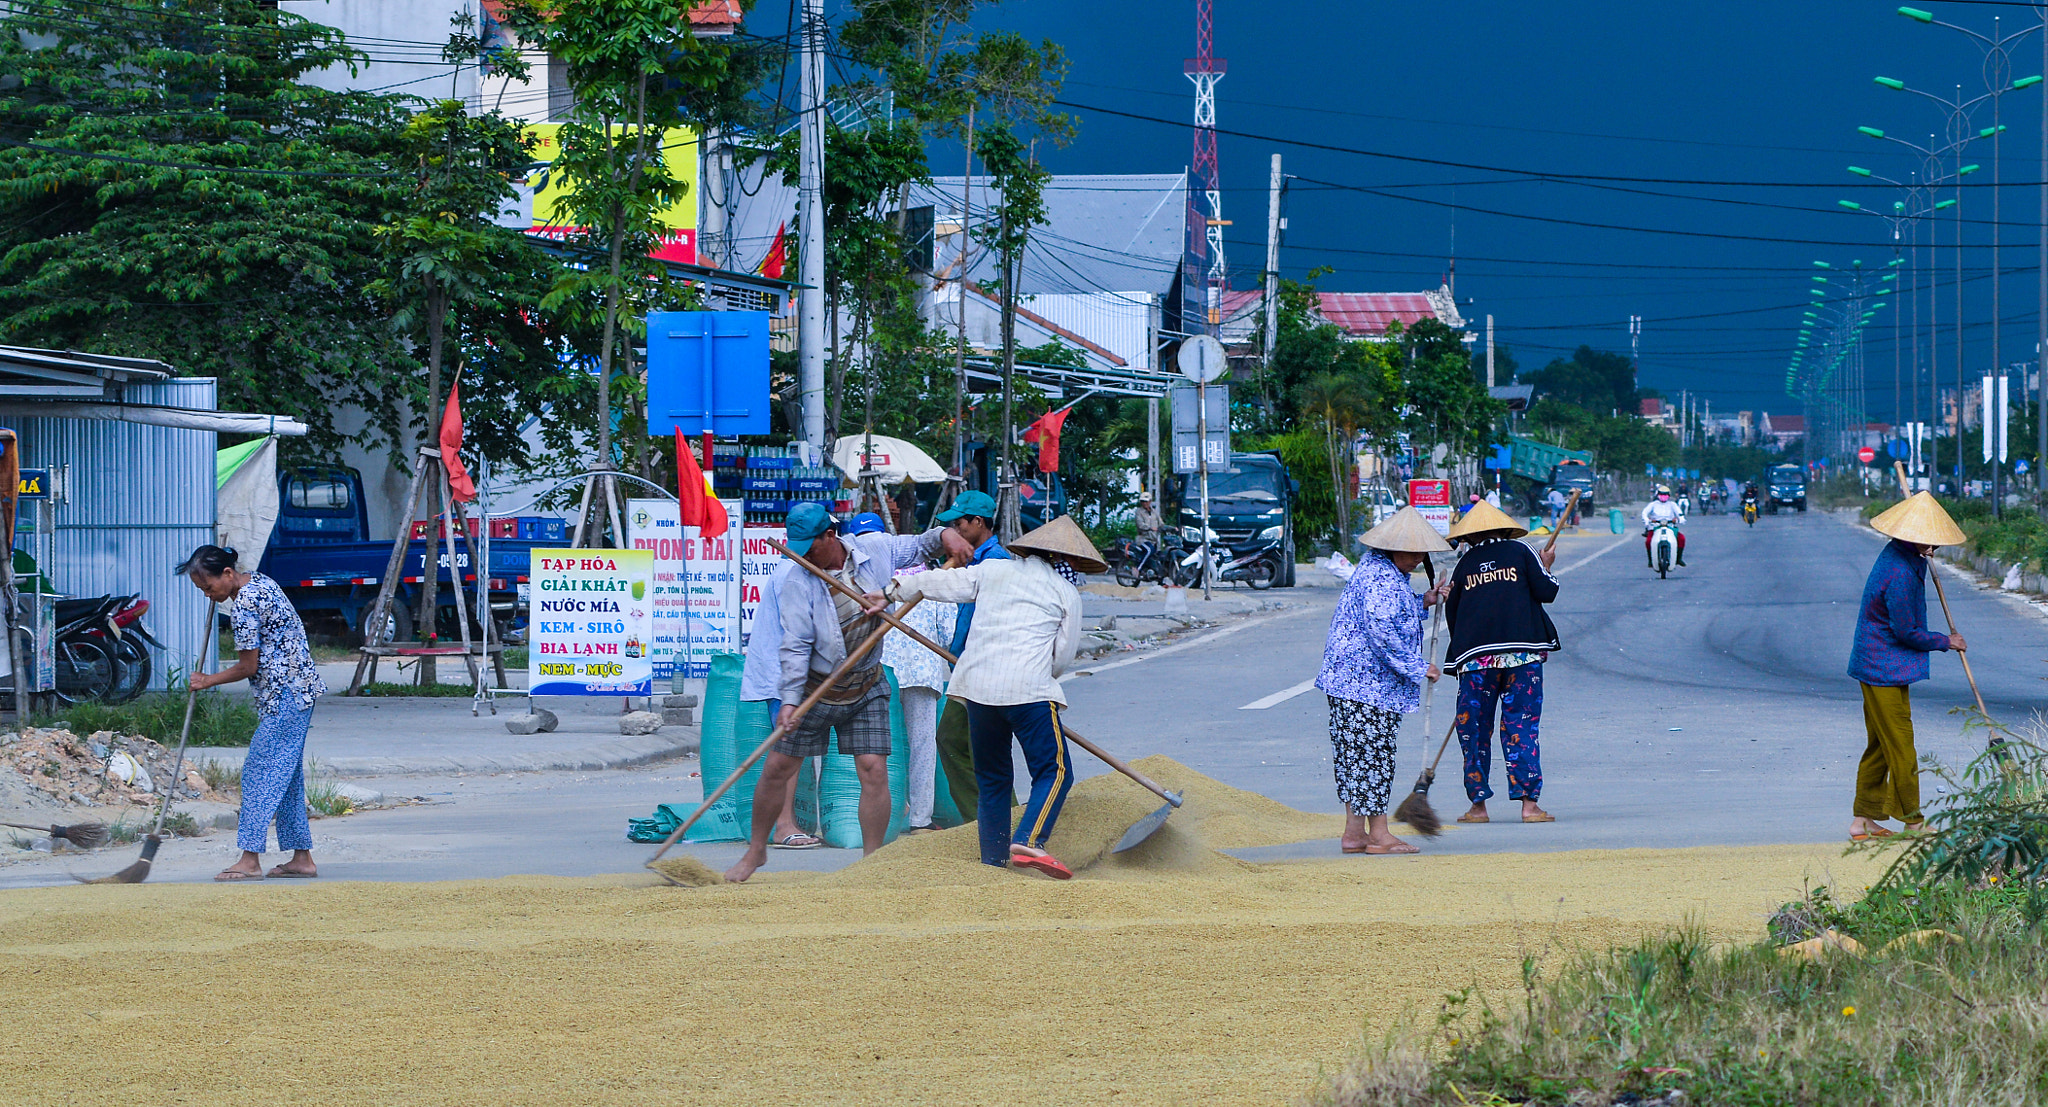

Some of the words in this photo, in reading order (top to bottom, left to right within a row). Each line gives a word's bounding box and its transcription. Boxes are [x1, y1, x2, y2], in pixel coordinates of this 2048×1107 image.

[541, 558, 576, 572] TẠP
[580, 555, 617, 571] HÓA
[540, 574, 577, 591] GIẢI
[581, 577, 628, 592] KHÁT
[1464, 567, 1518, 591] JUVENTUS
[540, 597, 586, 612] NƯỚC
[590, 597, 621, 613] MÍA
[540, 621, 575, 633] KEM
[586, 618, 625, 634] SIRÔ
[540, 642, 568, 654] BIA
[573, 643, 618, 657] LẠNH
[539, 663, 575, 675] NEM
[585, 661, 623, 678] MỰC
